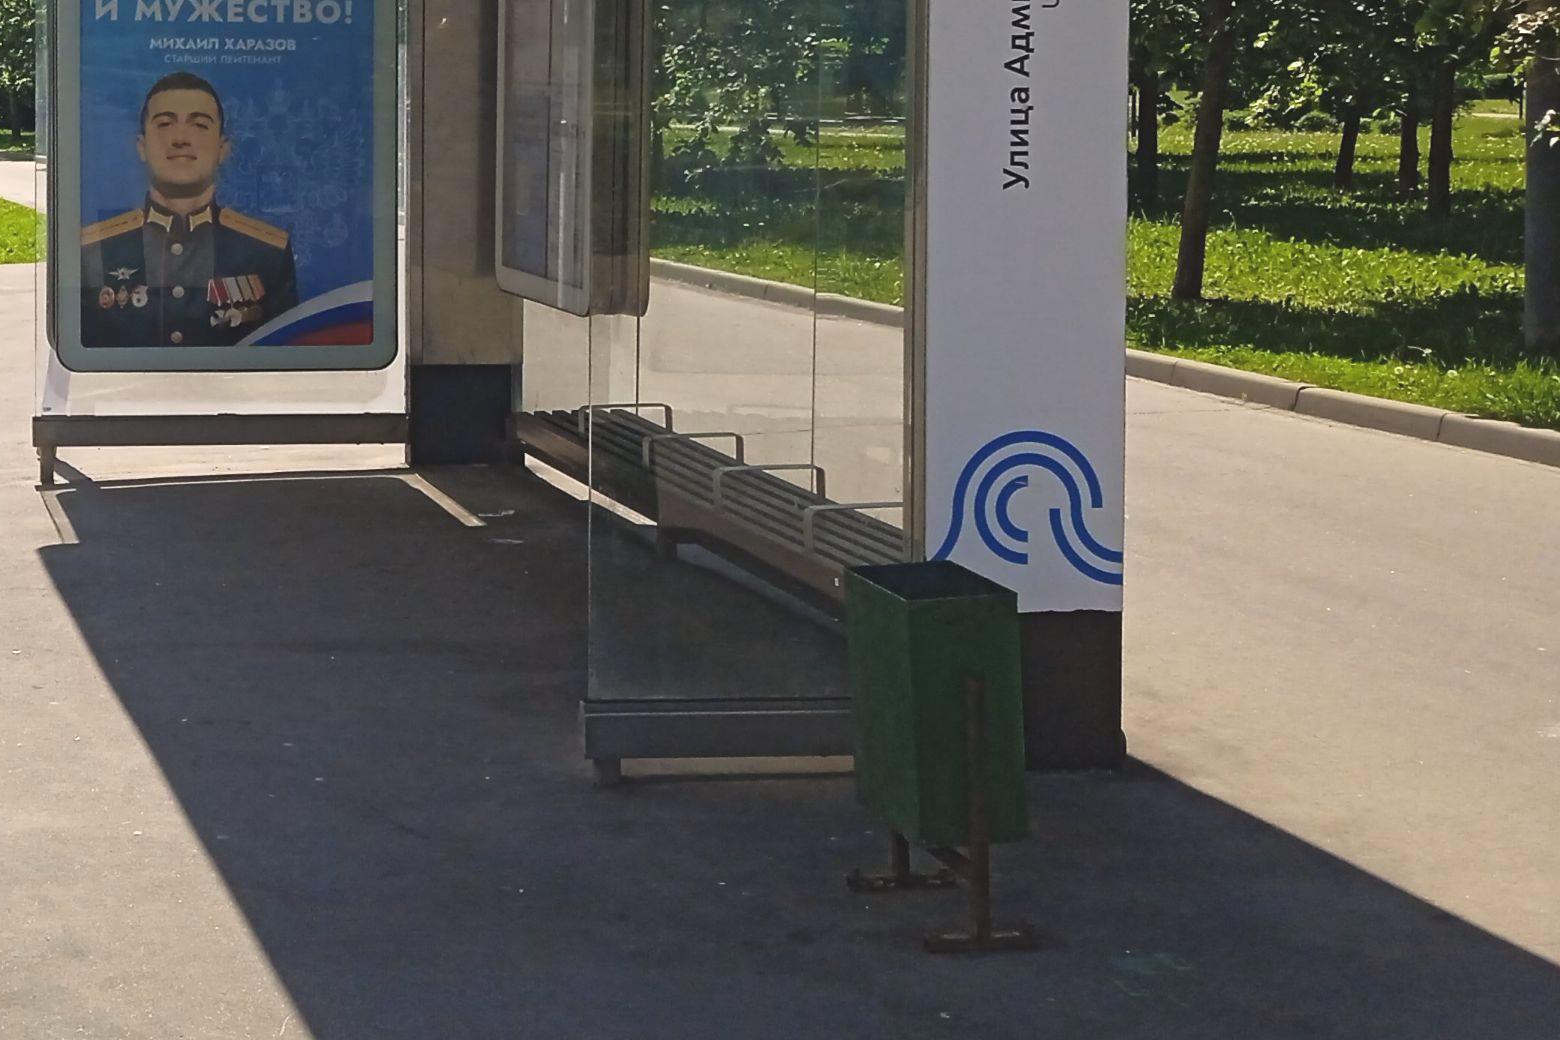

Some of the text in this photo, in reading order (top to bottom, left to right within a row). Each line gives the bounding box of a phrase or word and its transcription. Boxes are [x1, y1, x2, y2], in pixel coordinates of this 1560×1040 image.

[149, 37, 297, 51] МИХАИЛ ХАРАЗОВ
[1002, 86, 1034, 191] Улица
